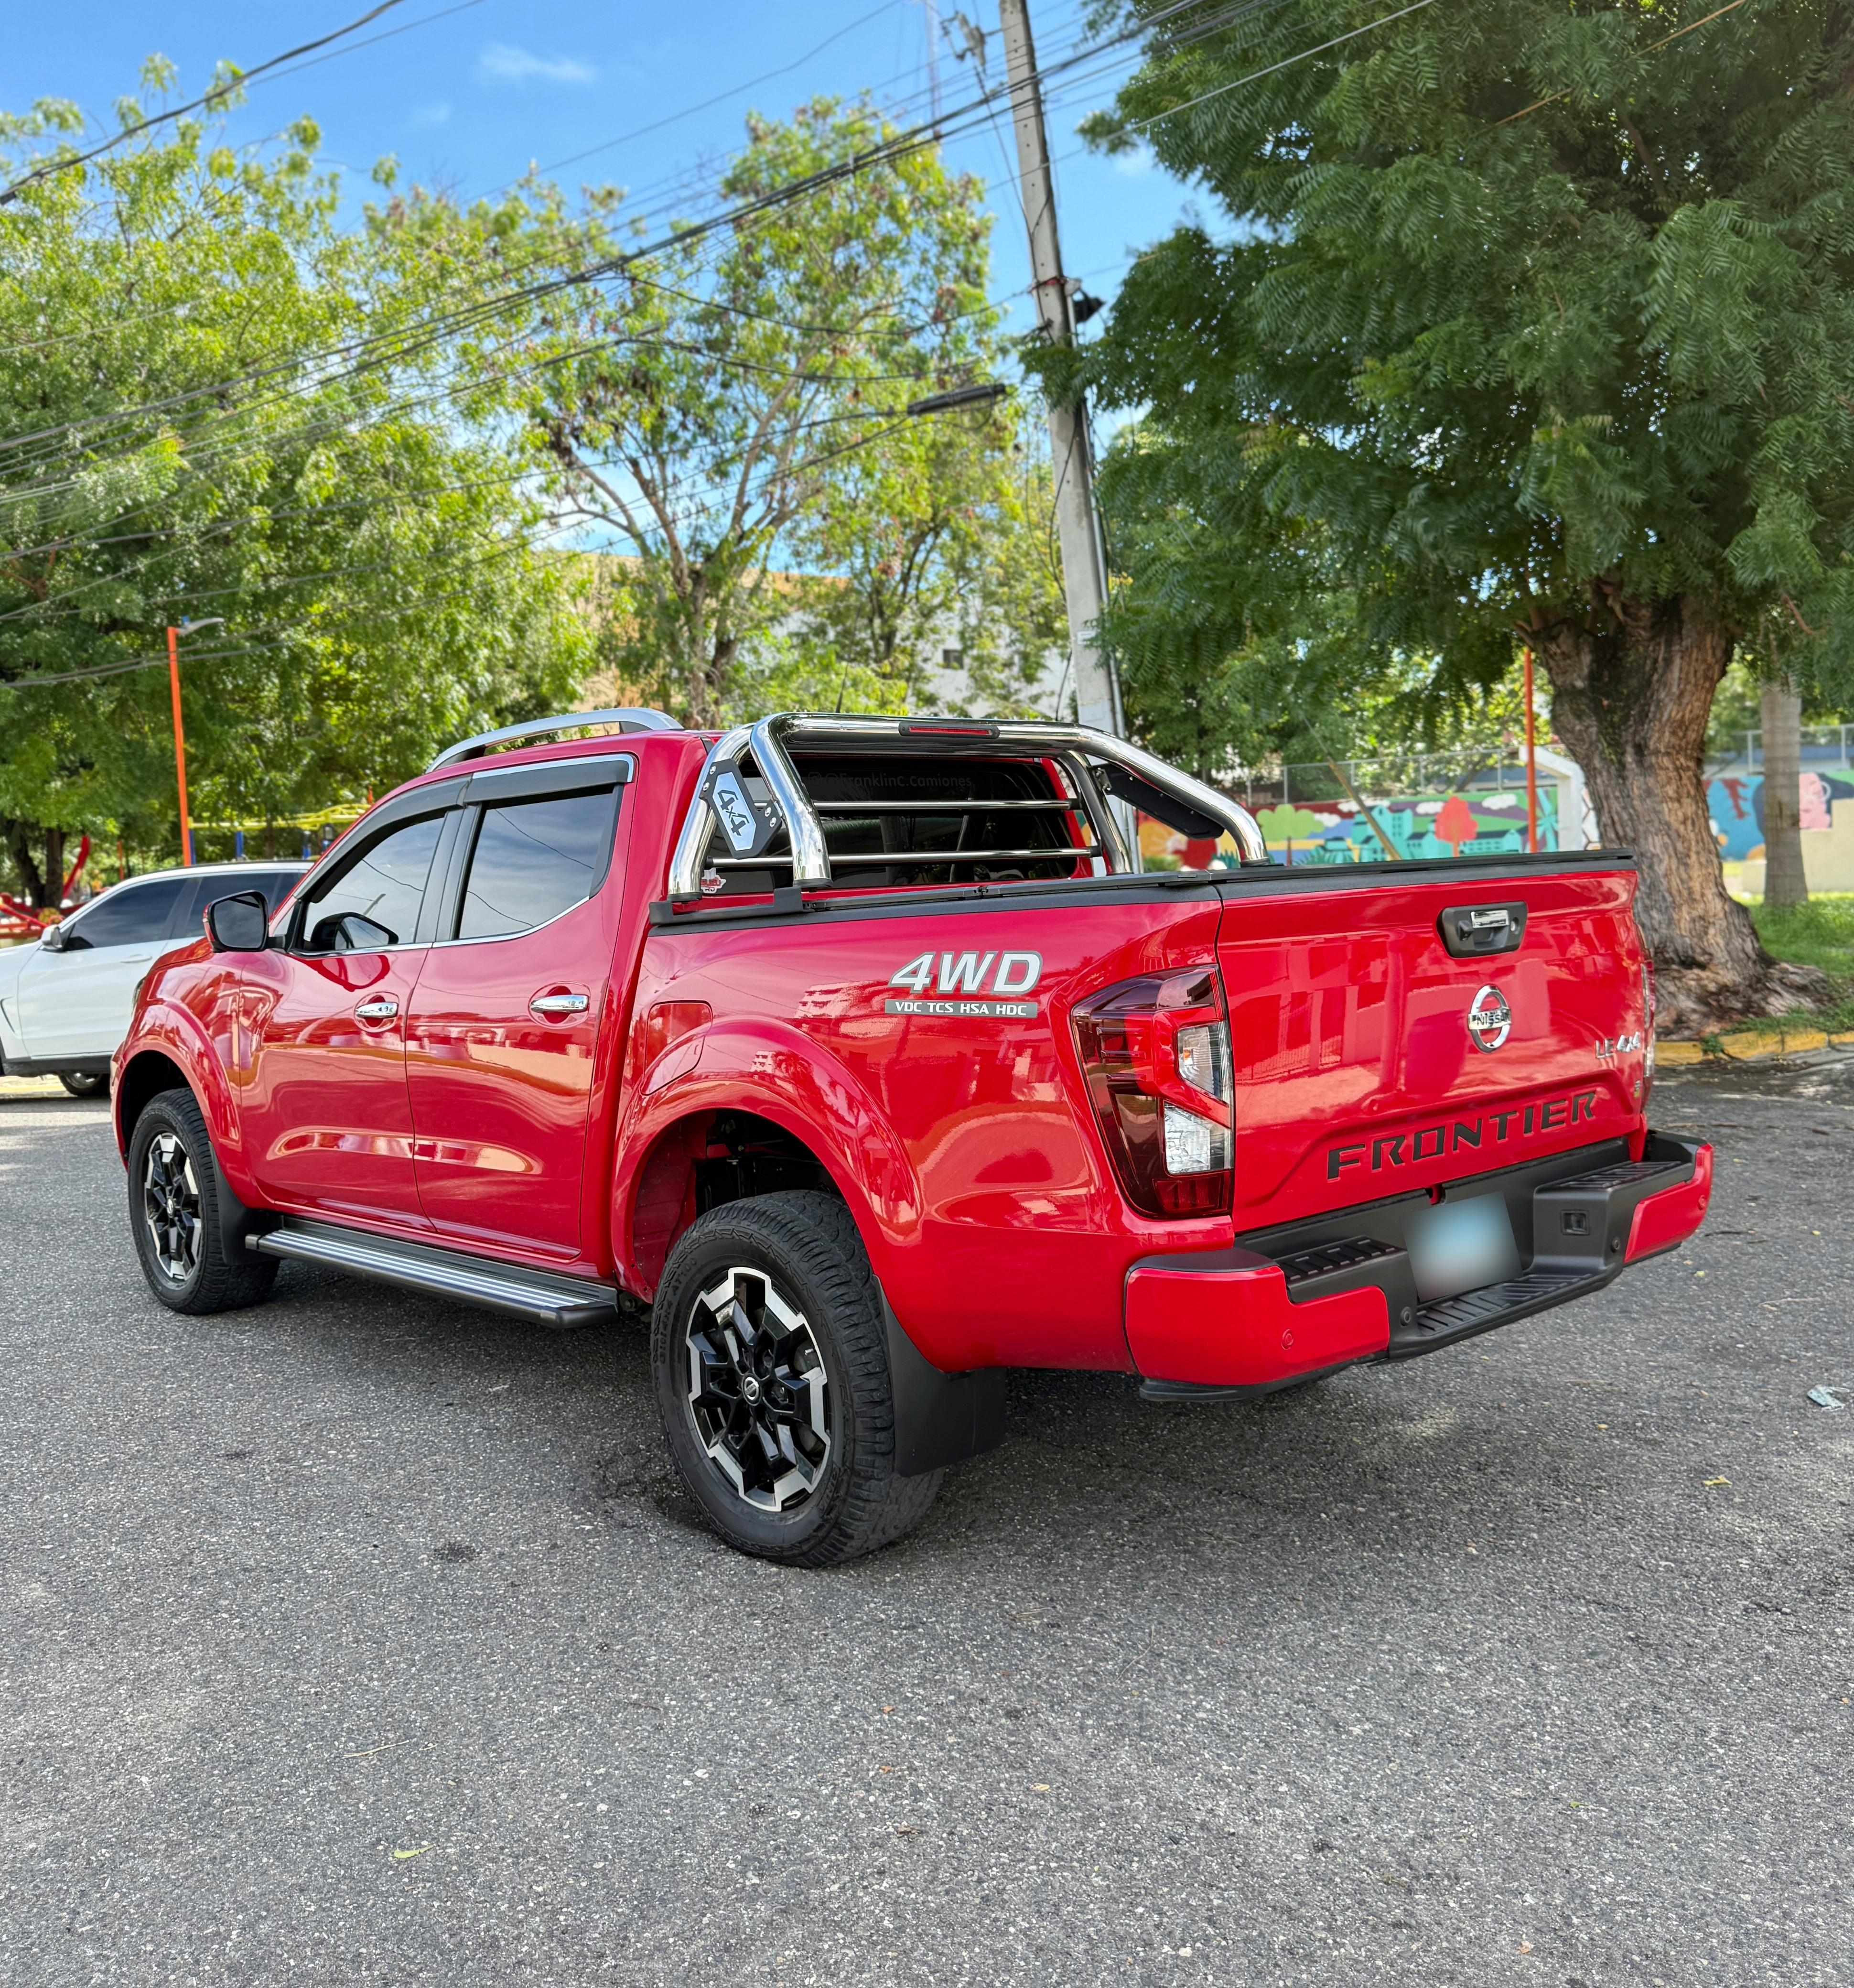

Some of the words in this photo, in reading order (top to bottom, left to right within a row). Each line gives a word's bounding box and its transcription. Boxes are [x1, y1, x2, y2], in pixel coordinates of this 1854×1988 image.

[887, 951, 1043, 995] 4WD
[895, 1001, 922, 1013] VDC
[927, 1002, 954, 1013] TCS
[959, 1003, 989, 1014] HSA
[996, 1004, 1027, 1016] HDC
[1595, 1038, 1615, 1059] LE
[1327, 1091, 1597, 1183] FRONTIER
